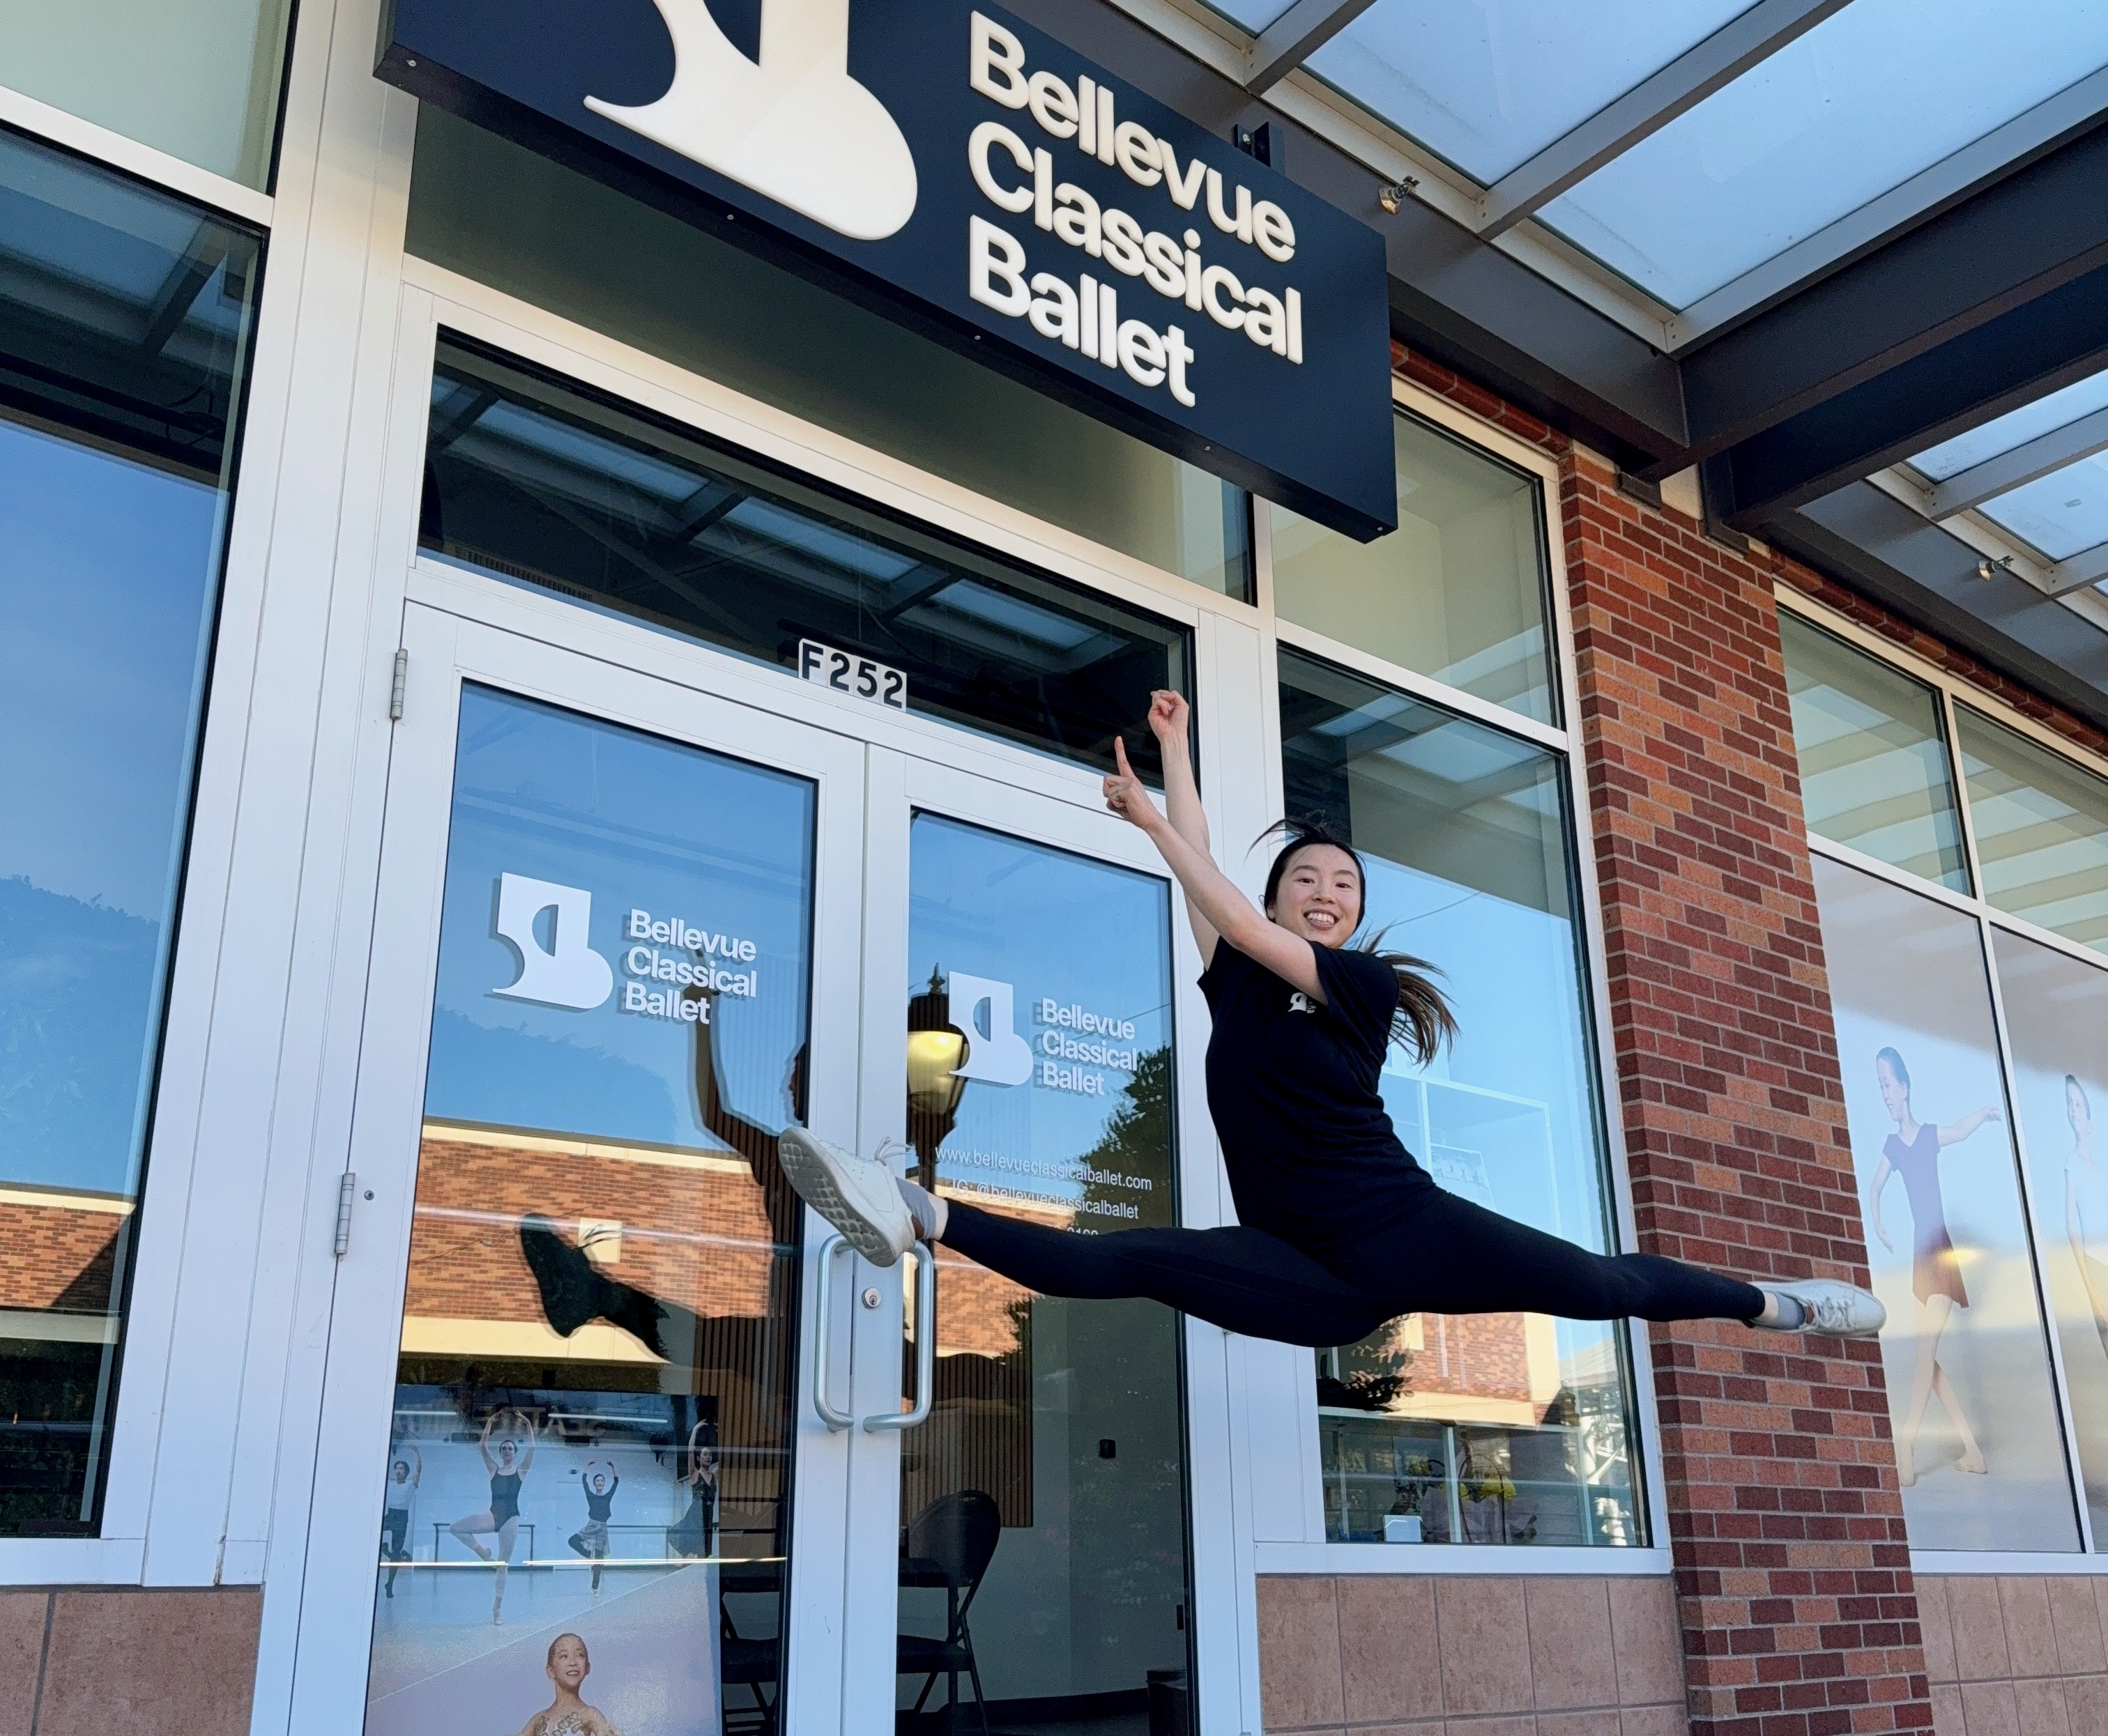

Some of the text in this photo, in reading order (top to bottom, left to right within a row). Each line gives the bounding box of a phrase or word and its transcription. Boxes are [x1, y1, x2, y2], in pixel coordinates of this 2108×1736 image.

[970, 10, 1296, 263] Bellevue
[968, 121, 1303, 364] Classical
[970, 214, 1196, 408] Ballet
[802, 642, 903, 709] F252
[629, 908, 756, 962] Bellevue
[627, 946, 757, 998] Classical
[625, 981, 710, 1024] Ballet
[1041, 997, 1136, 1040] Bellevue
[1041, 1029, 1138, 1072] Classical
[1041, 1060, 1105, 1096] Ballet
[935, 1146, 1152, 1191] www.bellevueclassicalballet.com
[977, 1182, 1139, 1220] @bellevueclassicalballet
